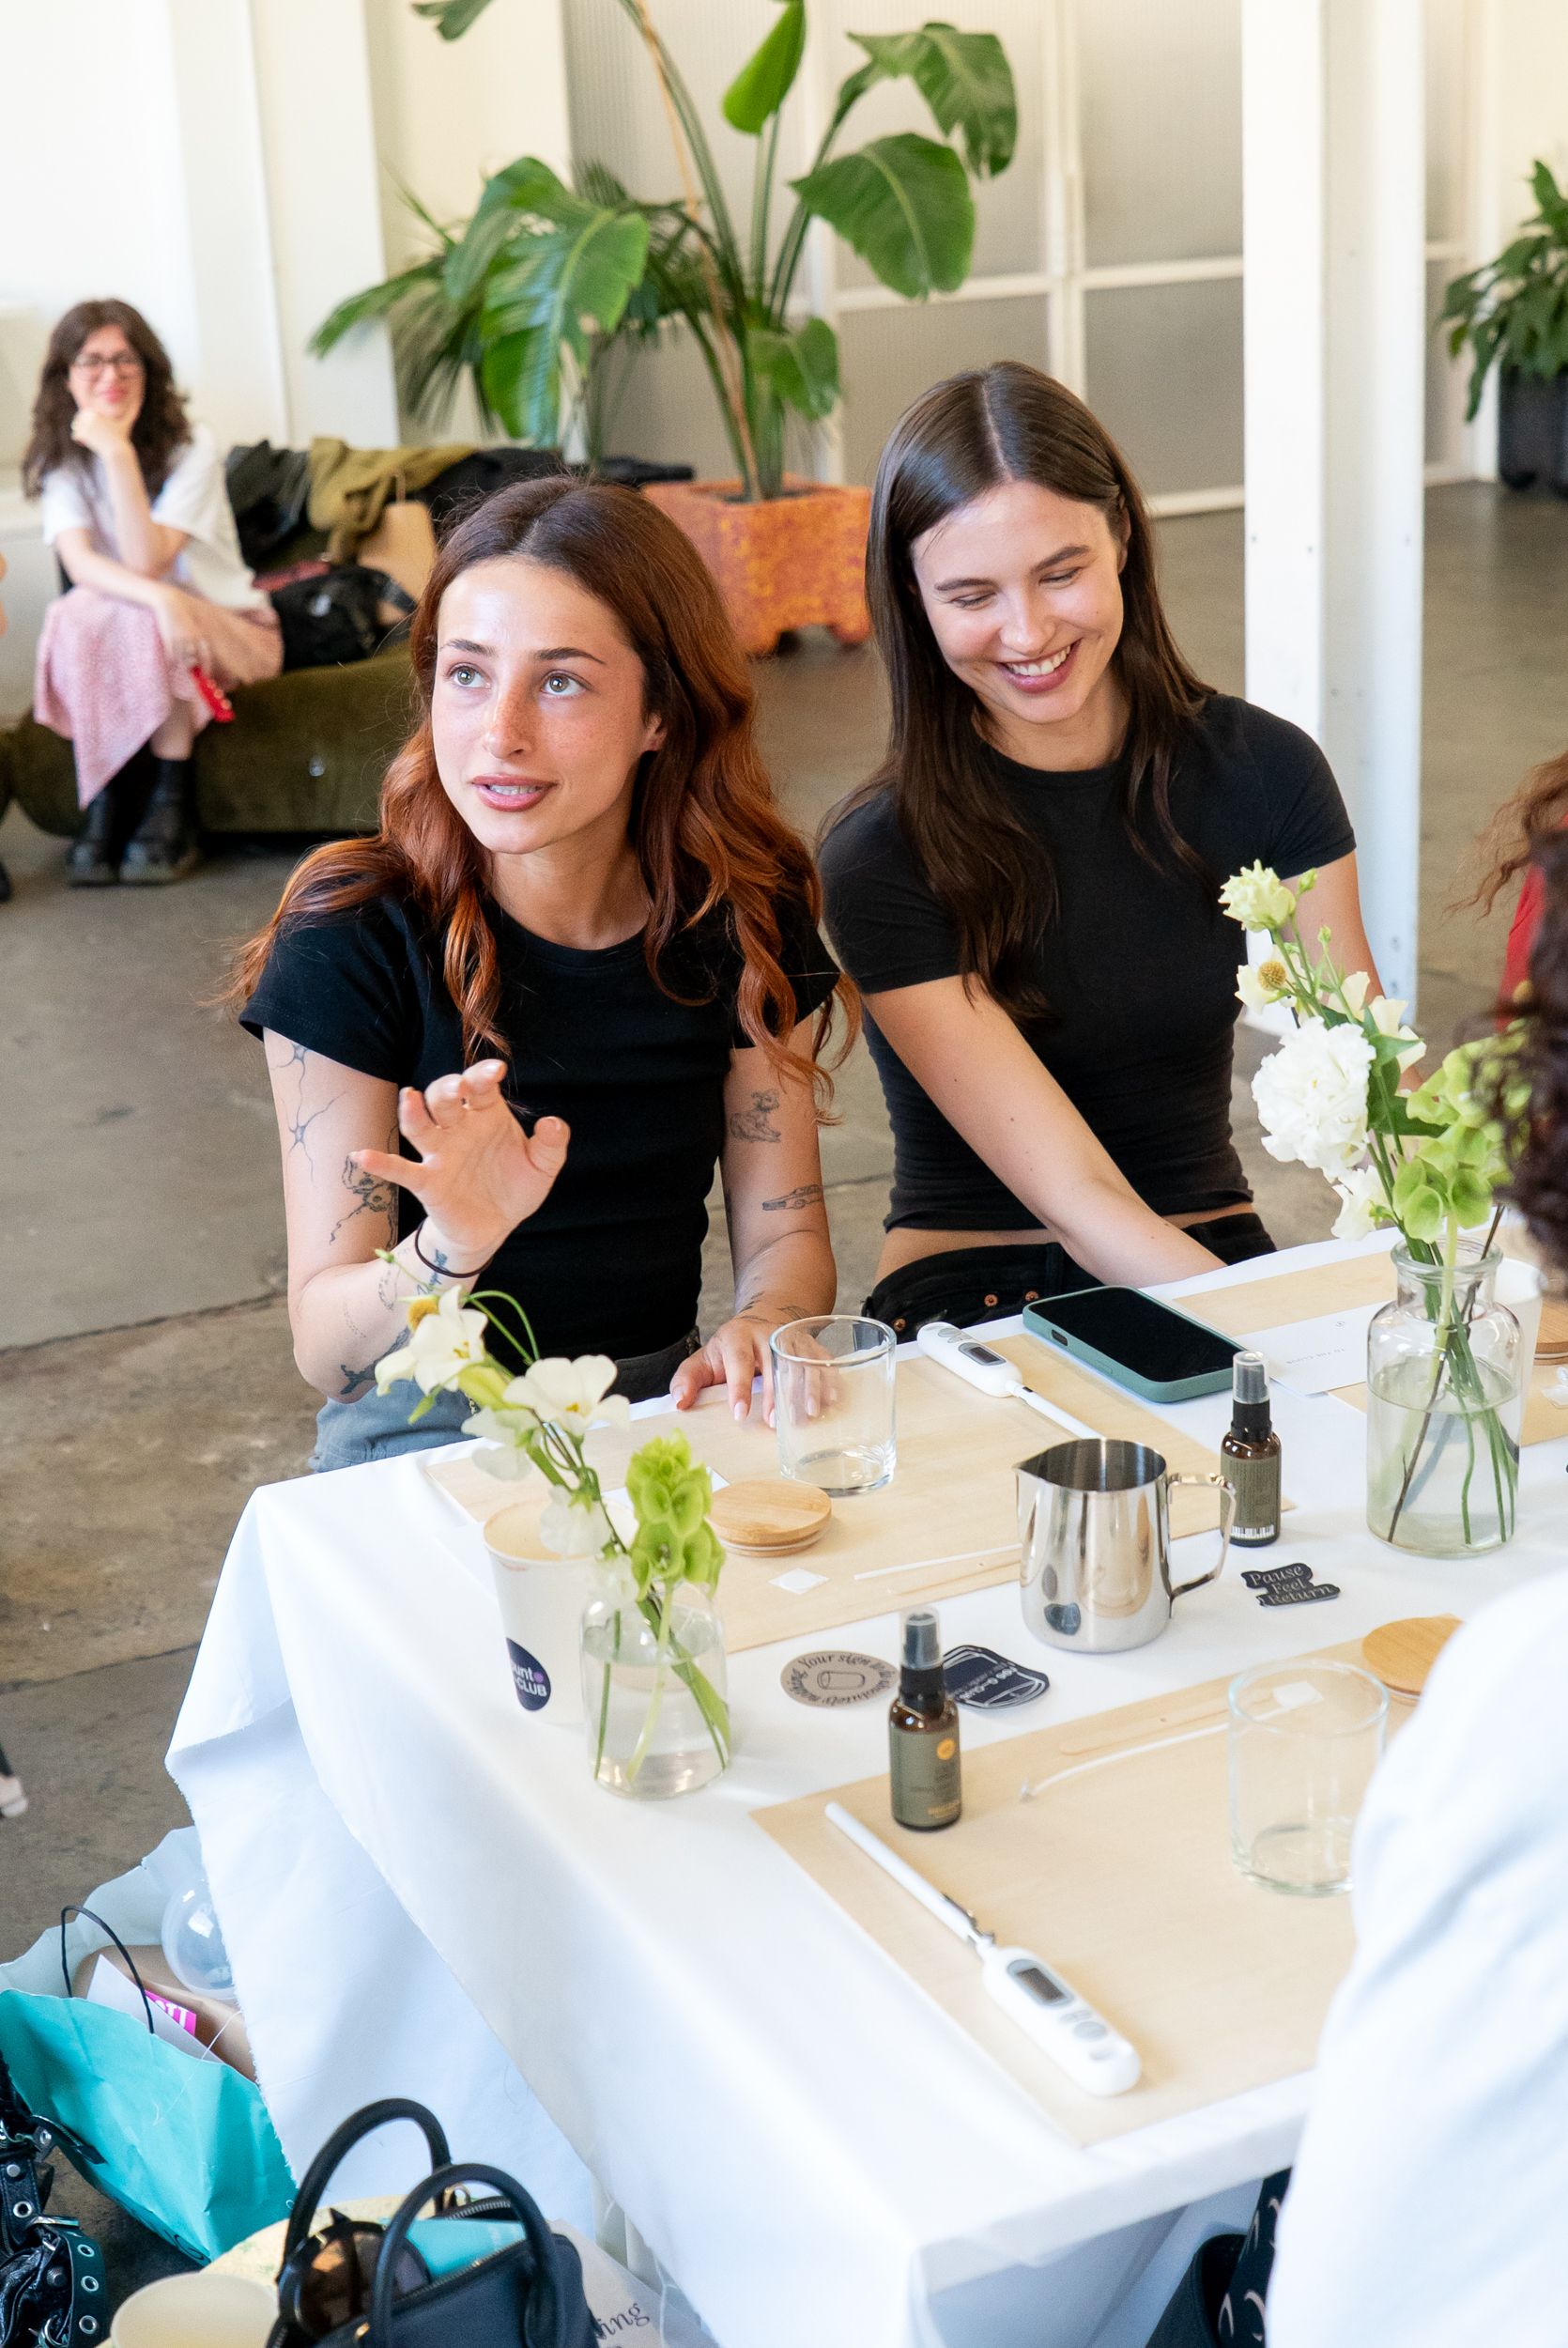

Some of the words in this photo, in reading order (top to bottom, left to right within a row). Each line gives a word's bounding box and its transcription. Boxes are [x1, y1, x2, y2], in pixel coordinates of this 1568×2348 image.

[1249, 1566, 1304, 1586] Pause
[1268, 1584, 1334, 1605] Return
[1271, 1579, 1307, 1595] Feel
[797, 1654, 834, 1669] Your
[838, 1653, 871, 1665] sign
[515, 1676, 547, 1697] CLUB
